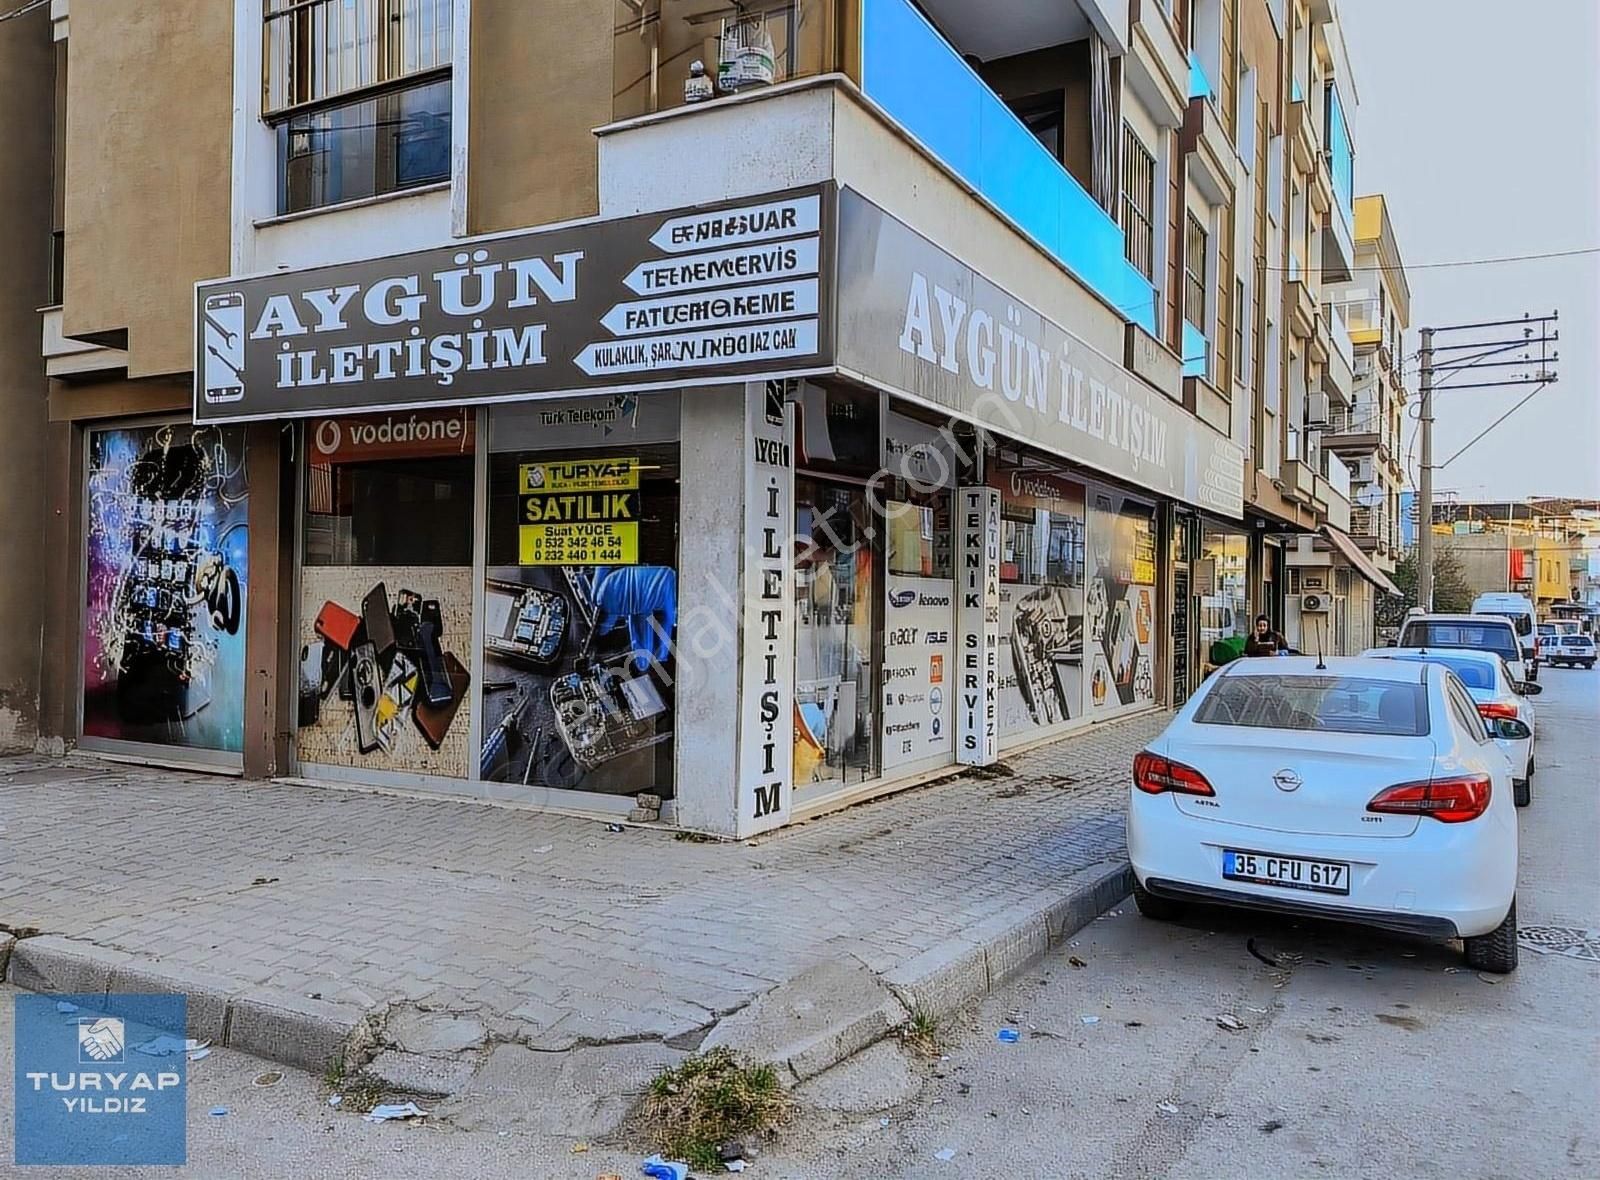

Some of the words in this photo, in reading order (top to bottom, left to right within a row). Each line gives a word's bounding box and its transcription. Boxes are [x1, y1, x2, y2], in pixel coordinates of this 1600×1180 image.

[249, 250, 584, 340] AYGÜN
[276, 319, 548, 388] İLETİŞİM
[899, 271, 1052, 416] AYGÜN
[568, 409, 616, 423] Telekom
[1057, 339, 1168, 473] İLETİŞİM
[350, 415, 461, 445] vodafone
[549, 463, 631, 480] TURYAP
[526, 494, 632, 521] SATILIK
[545, 538, 564, 548] 532
[567, 538, 588, 548] 342
[608, 537, 622, 547] 54
[576, 523, 613, 536] YÜCE
[545, 550, 564, 561] 232
[567, 550, 588, 560] 440
[600, 549, 622, 560] 444
[965, 493, 980, 608] TEKNİK
[964, 633, 978, 750] SERVİS
[1235, 855, 1257, 875] 35
[1267, 859, 1300, 880] CFU
[1310, 864, 1342, 885] 617
